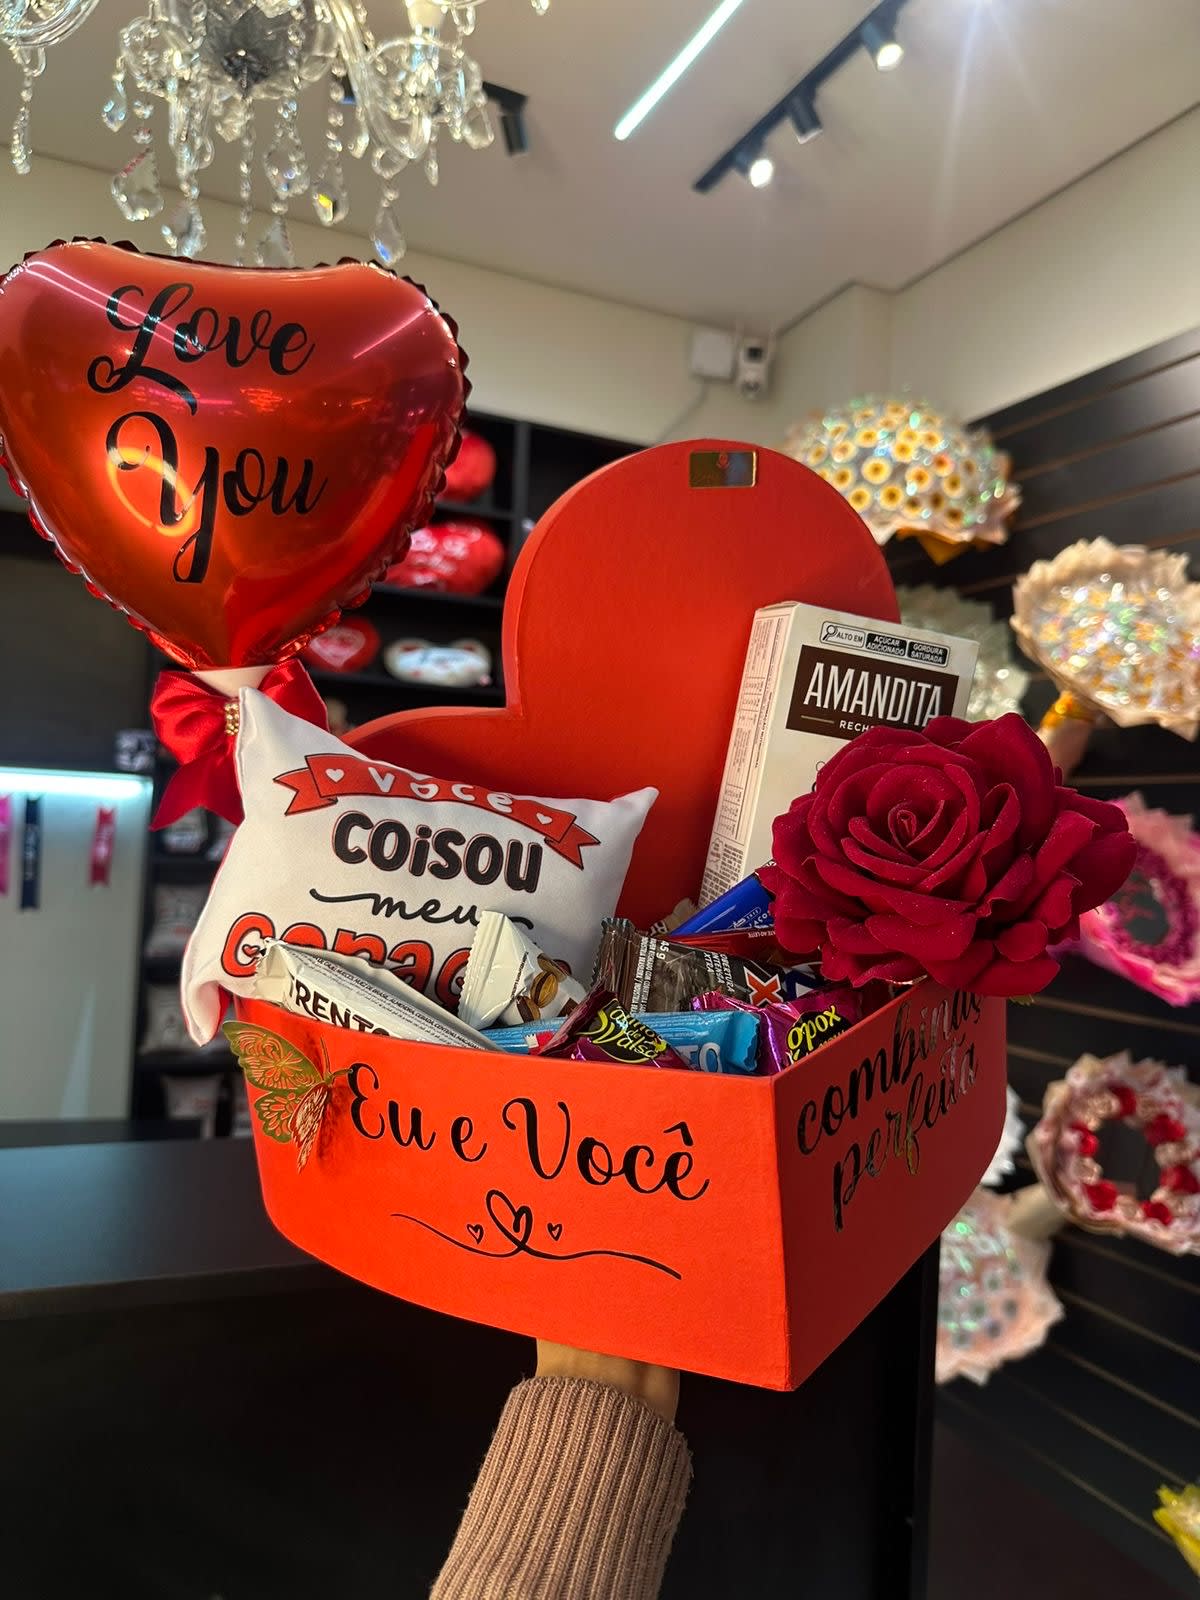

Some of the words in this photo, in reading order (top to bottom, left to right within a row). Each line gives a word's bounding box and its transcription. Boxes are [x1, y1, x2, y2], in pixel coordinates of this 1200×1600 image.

[87, 283, 315, 416] Love
[106, 411, 328, 583] You
[836, 631, 852, 641] ALTO
[854, 635, 863, 643] EM
[866, 642, 905, 656] ADICIONADO
[910, 650, 943, 664] SATURADA
[912, 643, 944, 656] GORDURA
[803, 662, 942, 728] AMANDITA
[309, 888, 481, 929] meu
[656, 952, 666, 960] g
[719, 953, 735, 992] OBERTURA
[347, 1062, 436, 1151] Eu
[450, 1116, 488, 1162] e
[502, 1097, 710, 1201] Você
[832, 1033, 979, 1232] perfeita
